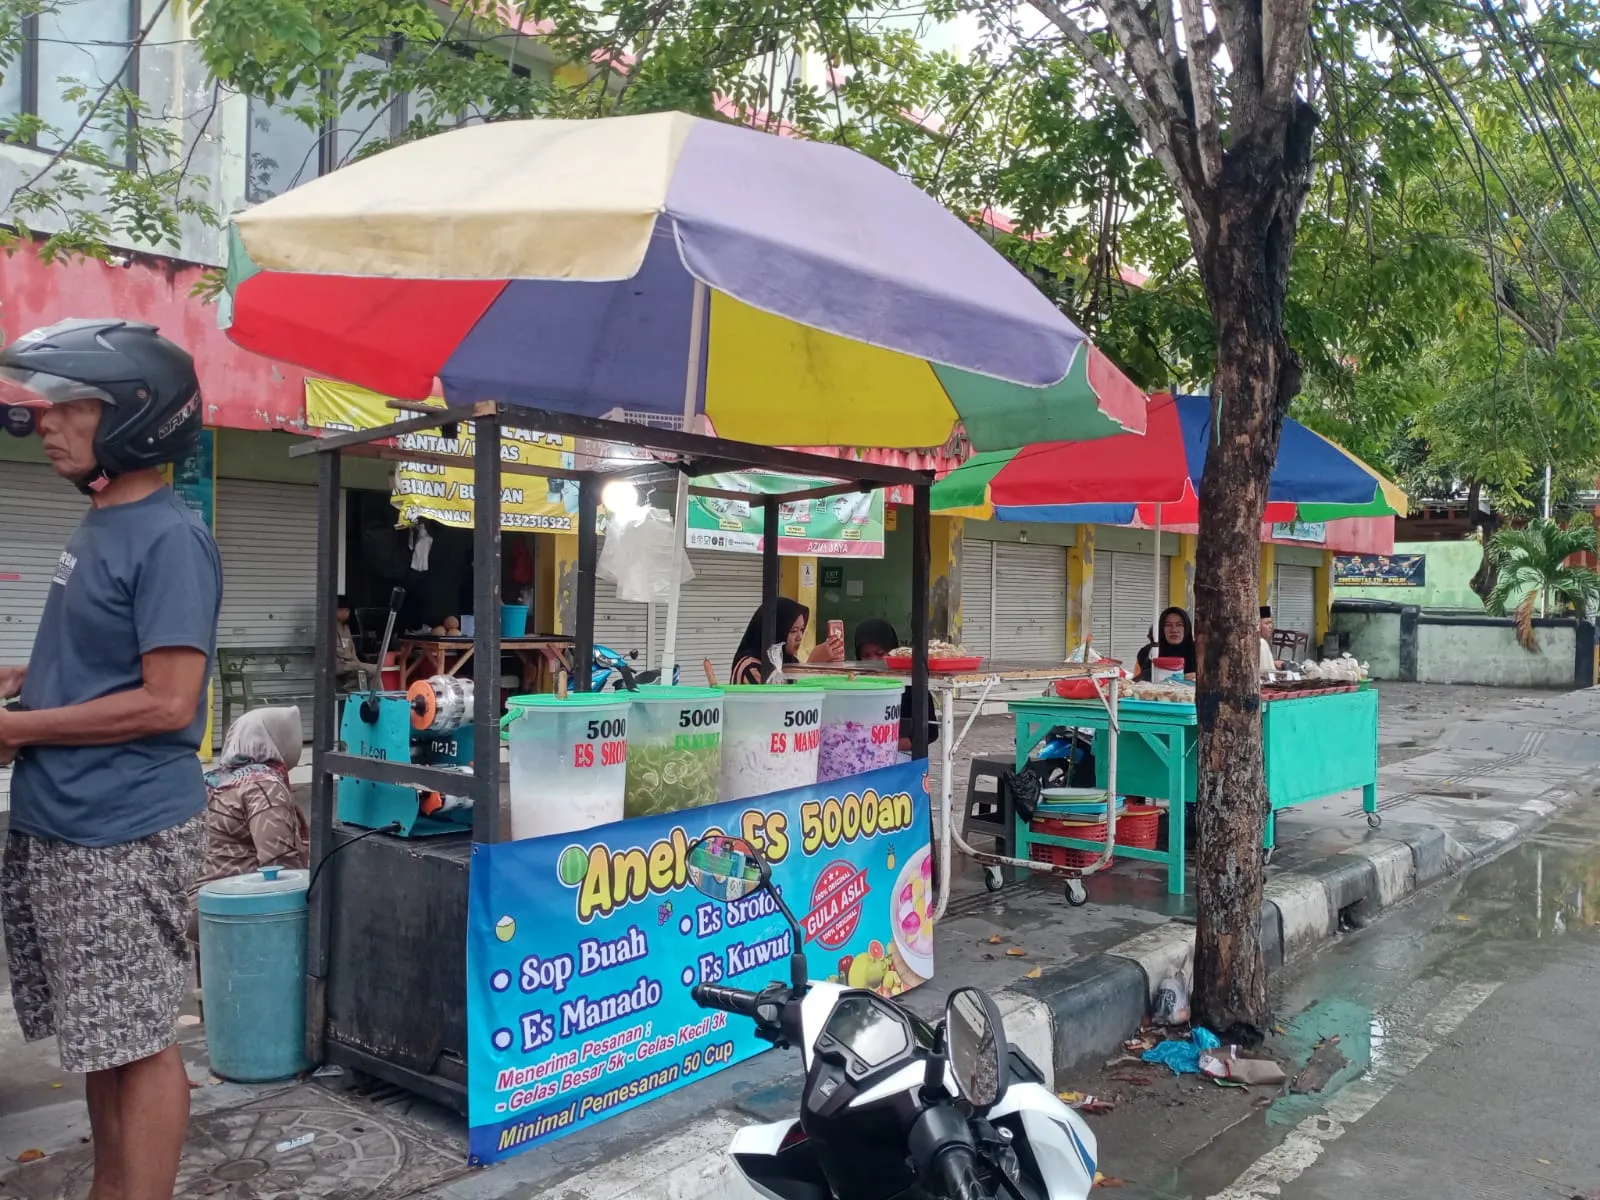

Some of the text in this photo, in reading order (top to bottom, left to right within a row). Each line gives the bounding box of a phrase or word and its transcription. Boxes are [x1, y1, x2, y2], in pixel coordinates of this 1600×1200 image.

[587, 718, 626, 739] 5000
[679, 707, 720, 728] 5000
[770, 732, 787, 753] ES
[783, 708, 819, 727] 5000
[871, 724, 890, 745] SOP
[574, 743, 594, 768] ES
[578, 826, 727, 923] Anek
[801, 788, 914, 855] 5000an
[696, 902, 722, 938] Es
[807, 876, 865, 935] GULA ASLI
[520, 926, 648, 993] Sop Buah
[698, 929, 791, 985] Es Kuwut
[520, 976, 662, 1052] Es Manado
[496, 1051, 578, 1091] Menerima
[582, 1024, 643, 1060] Pesanan
[510, 1081, 557, 1112] Gelas
[560, 1061, 607, 1092] Besar
[607, 1051, 626, 1073] 5k
[636, 1035, 676, 1060] Gelas
[677, 1018, 710, 1045] Kecil
[711, 1012, 727, 1031] 3k
[498, 1040, 734, 1152] Minimal Pemesanan 50 Cup
